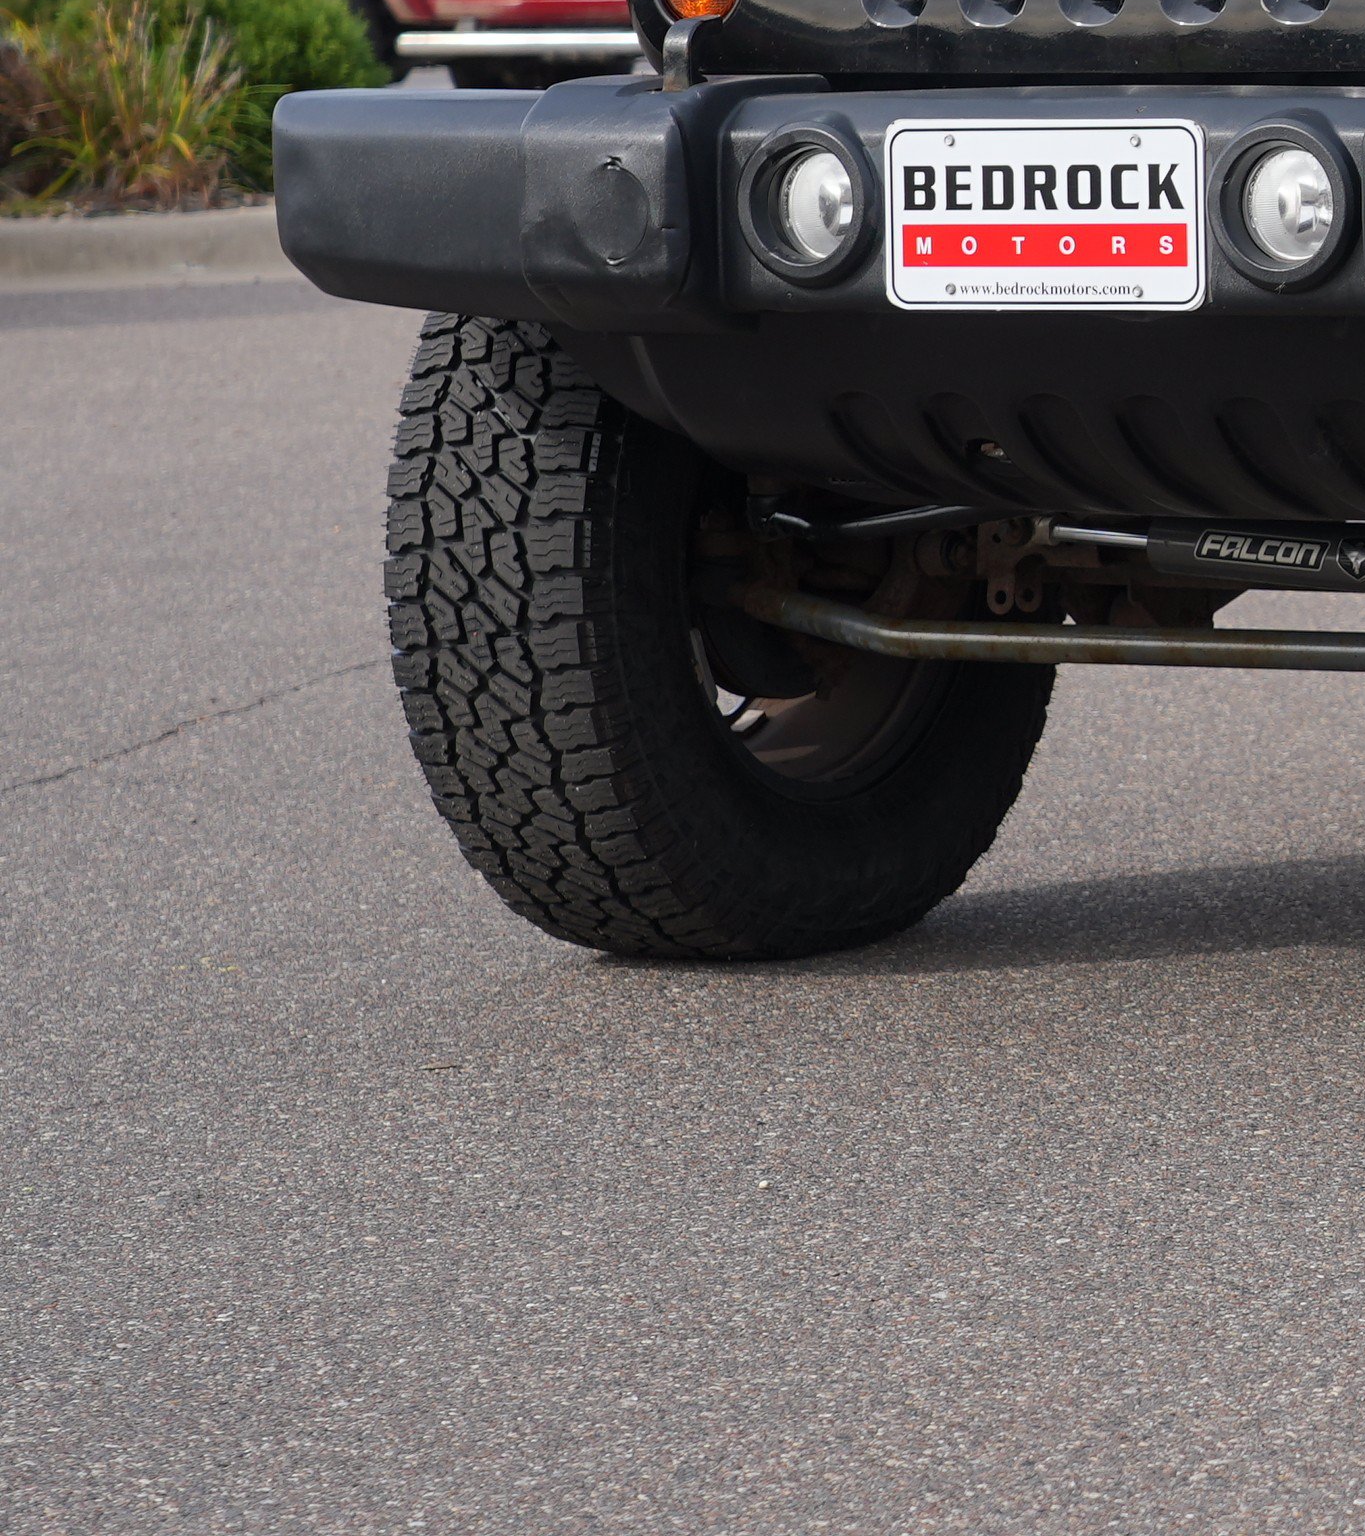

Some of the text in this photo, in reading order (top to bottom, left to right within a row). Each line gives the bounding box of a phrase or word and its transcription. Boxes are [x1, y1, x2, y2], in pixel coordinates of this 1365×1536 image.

[903, 164, 1185, 211] BEDROCK
[915, 235, 1174, 256] MOTORS
[960, 281, 1131, 296] www.bedrockmotors.com
[1200, 534, 1323, 566] FALCON
